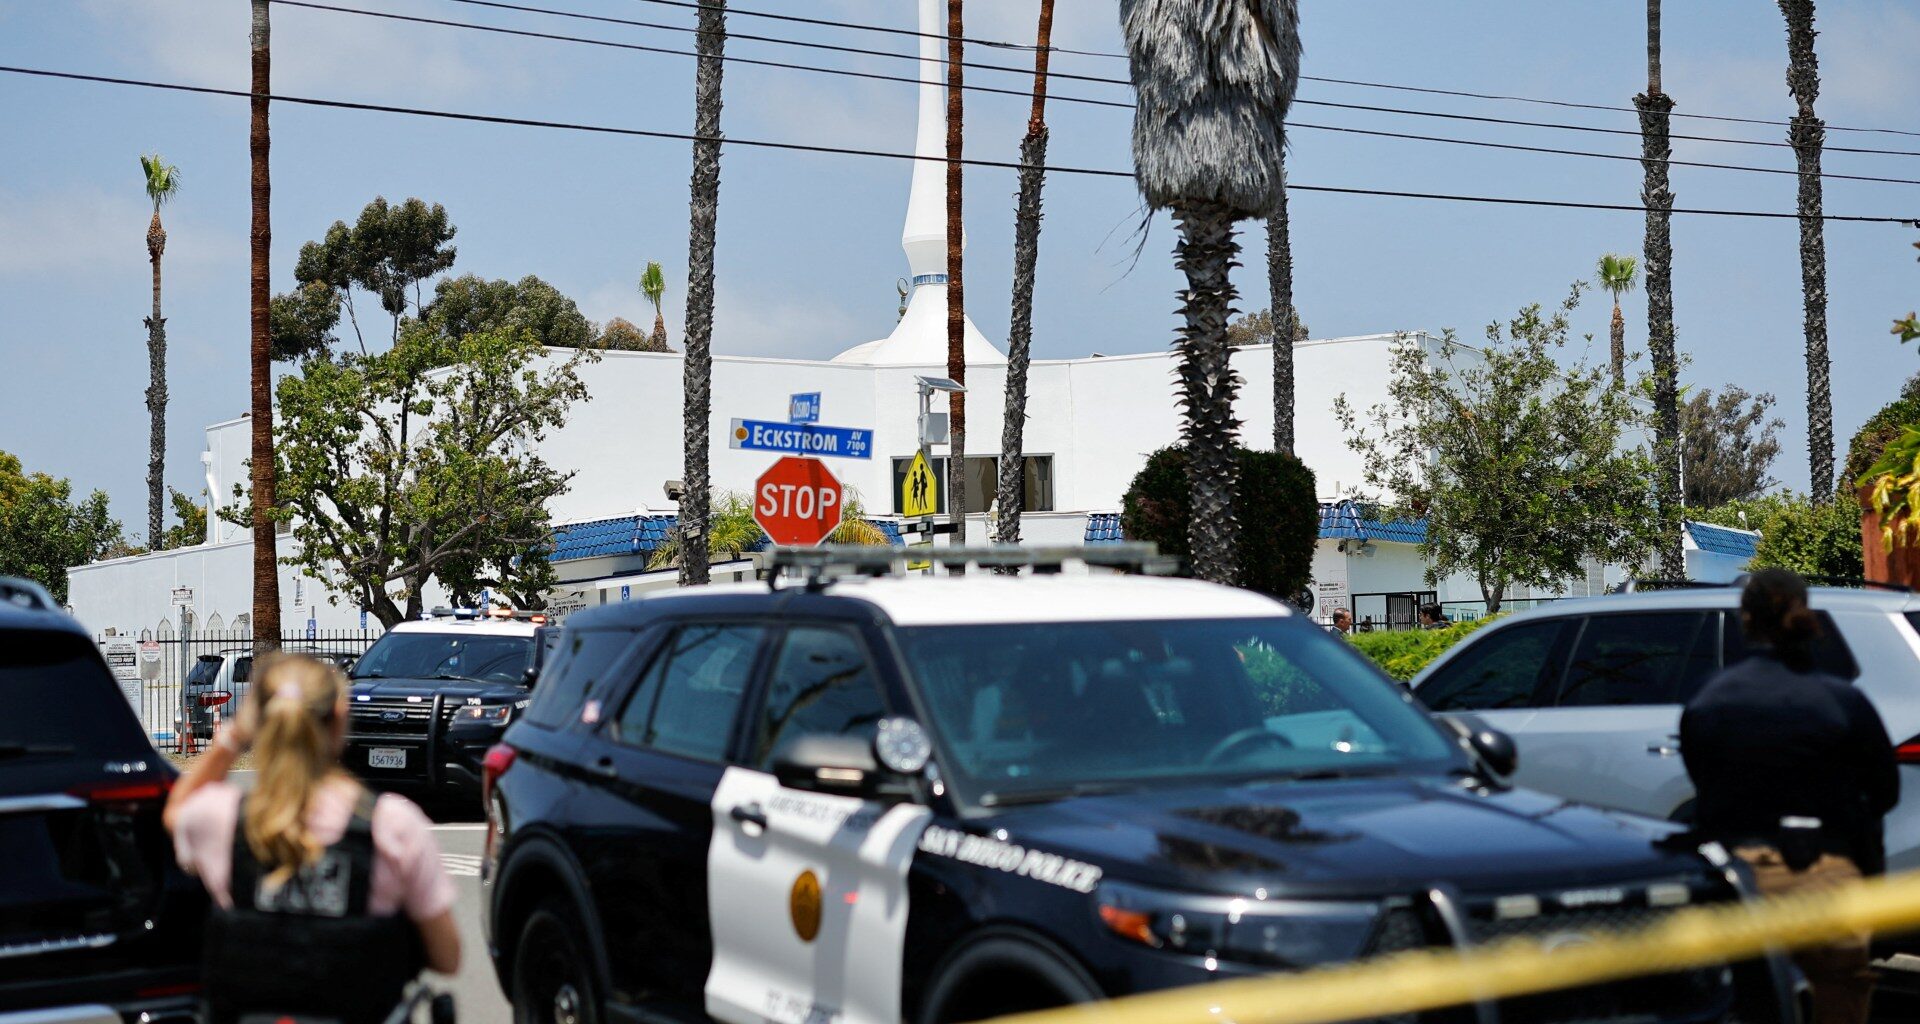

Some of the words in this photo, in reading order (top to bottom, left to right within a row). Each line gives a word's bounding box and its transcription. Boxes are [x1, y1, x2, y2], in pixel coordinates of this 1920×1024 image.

[753, 425, 838, 452] ECKSTROM
[846, 440, 866, 451] 7100
[851, 431, 862, 441] AV
[759, 483, 837, 520] STOP
[372, 755, 403, 767] 1567936
[1016, 849, 1103, 893] POLICE
